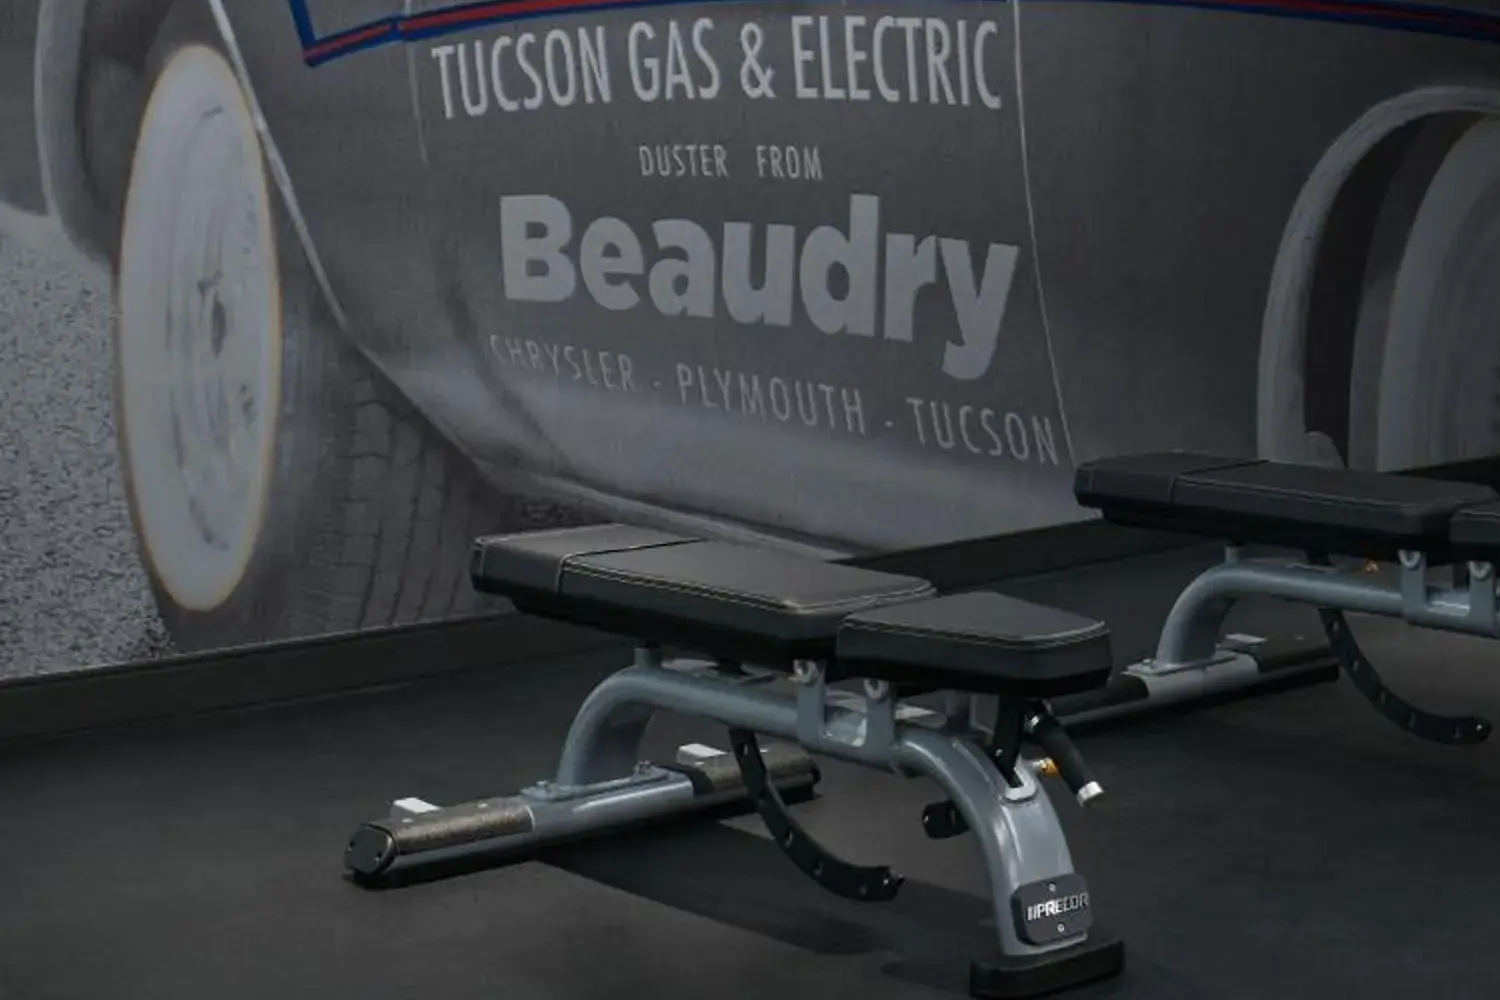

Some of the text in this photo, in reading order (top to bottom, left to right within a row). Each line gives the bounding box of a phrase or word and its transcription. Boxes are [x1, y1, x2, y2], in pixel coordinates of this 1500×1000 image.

[431, 14, 1002, 119] TUCSON GAS & ELECTRIC
[639, 144, 824, 182] DUSTER FROM
[500, 193, 1020, 381] Beaudry
[489, 333, 636, 392] CHRYSLER
[676, 362, 866, 436] PLYMOUTH
[905, 396, 1059, 467] TUCSON
[1036, 891, 1090, 919] PRECOR
